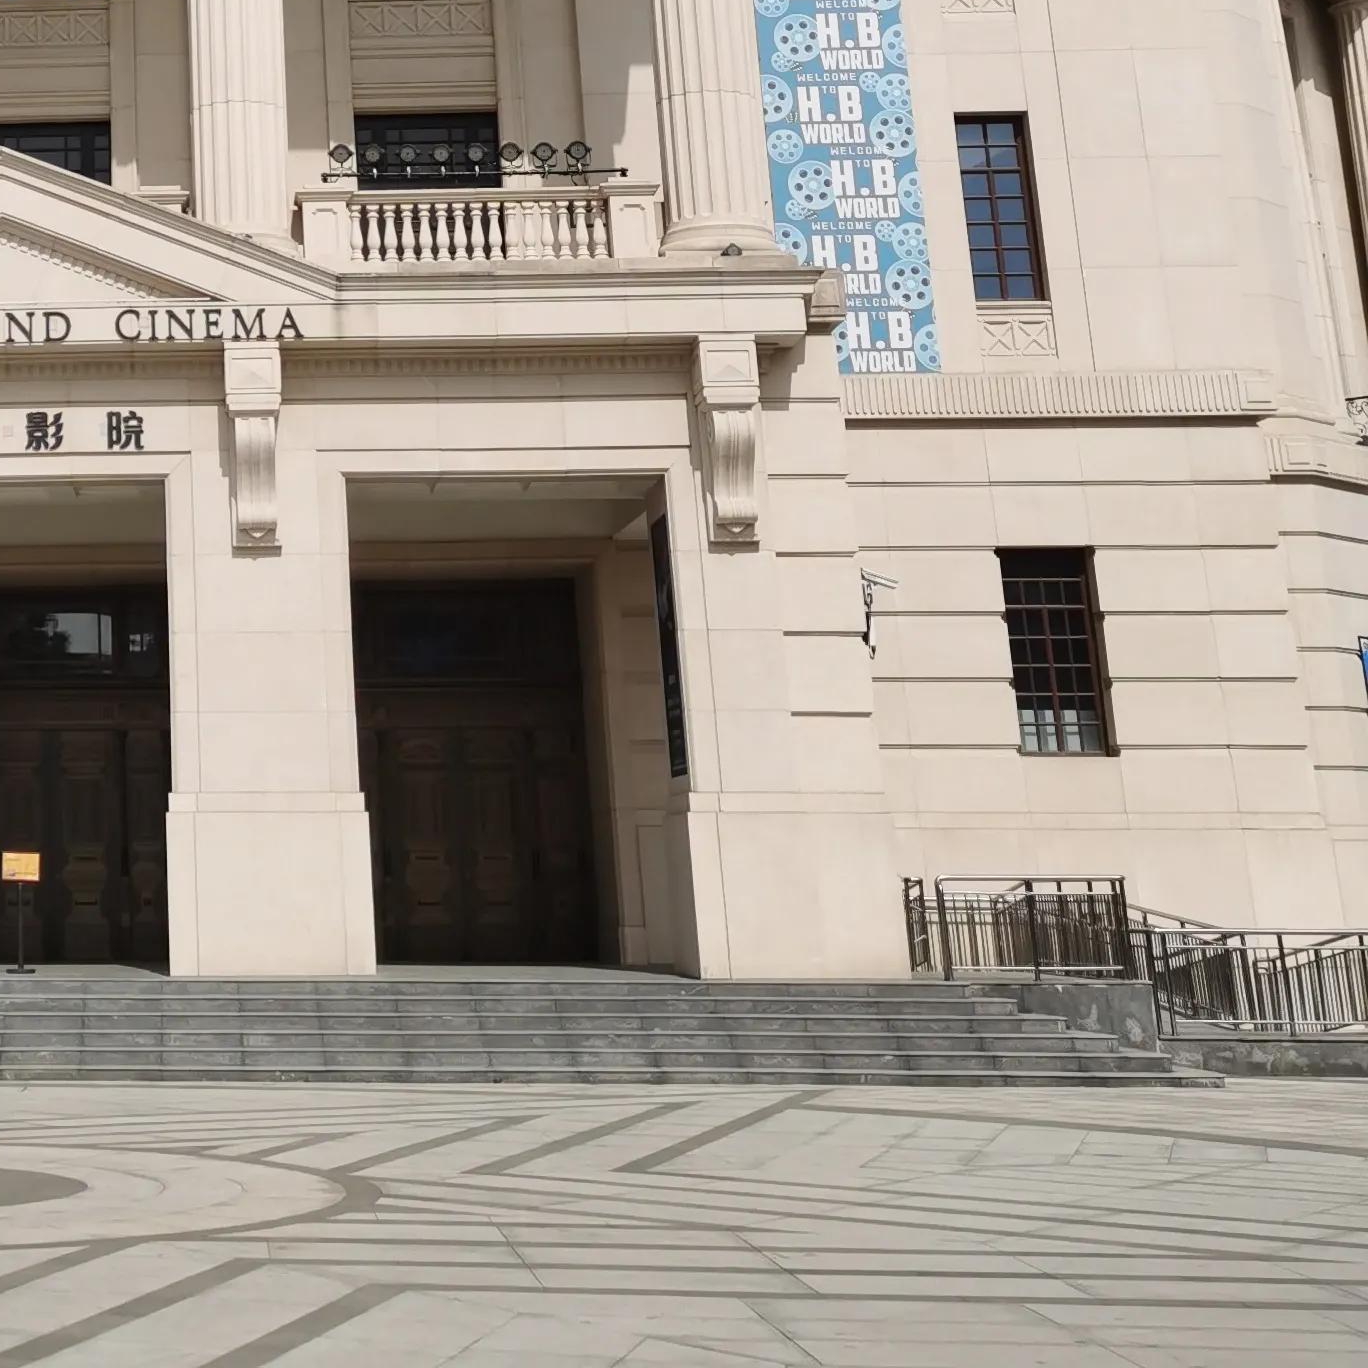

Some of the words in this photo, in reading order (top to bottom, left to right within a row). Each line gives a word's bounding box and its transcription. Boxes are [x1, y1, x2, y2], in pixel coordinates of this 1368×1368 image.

[816, 0, 873, 9] WELCOM
[816, 12, 881, 48] H.B
[820, 50, 884, 70] WORLD
[797, 73, 856, 82] WELCOME
[822, 86, 836, 94] TO
[797, 85, 862, 122] H.B
[801, 123, 866, 144] WORLD
[831, 146, 888, 155] WELCOM
[855, 159, 870, 167] TO
[831, 160, 896, 195] H.B
[835, 197, 900, 218] WORLD
[812, 221, 872, 230] WELCOME
[836, 235, 851, 243] TO
[812, 234, 878, 271] H.B
[845, 273, 881, 295] RLD
[846, 298, 904, 307] WELCOM
[115, 307, 304, 343] CINEMA
[871, 312, 887, 320] TO
[846, 311, 913, 349] H.B
[850, 351, 917, 373] WORLD
